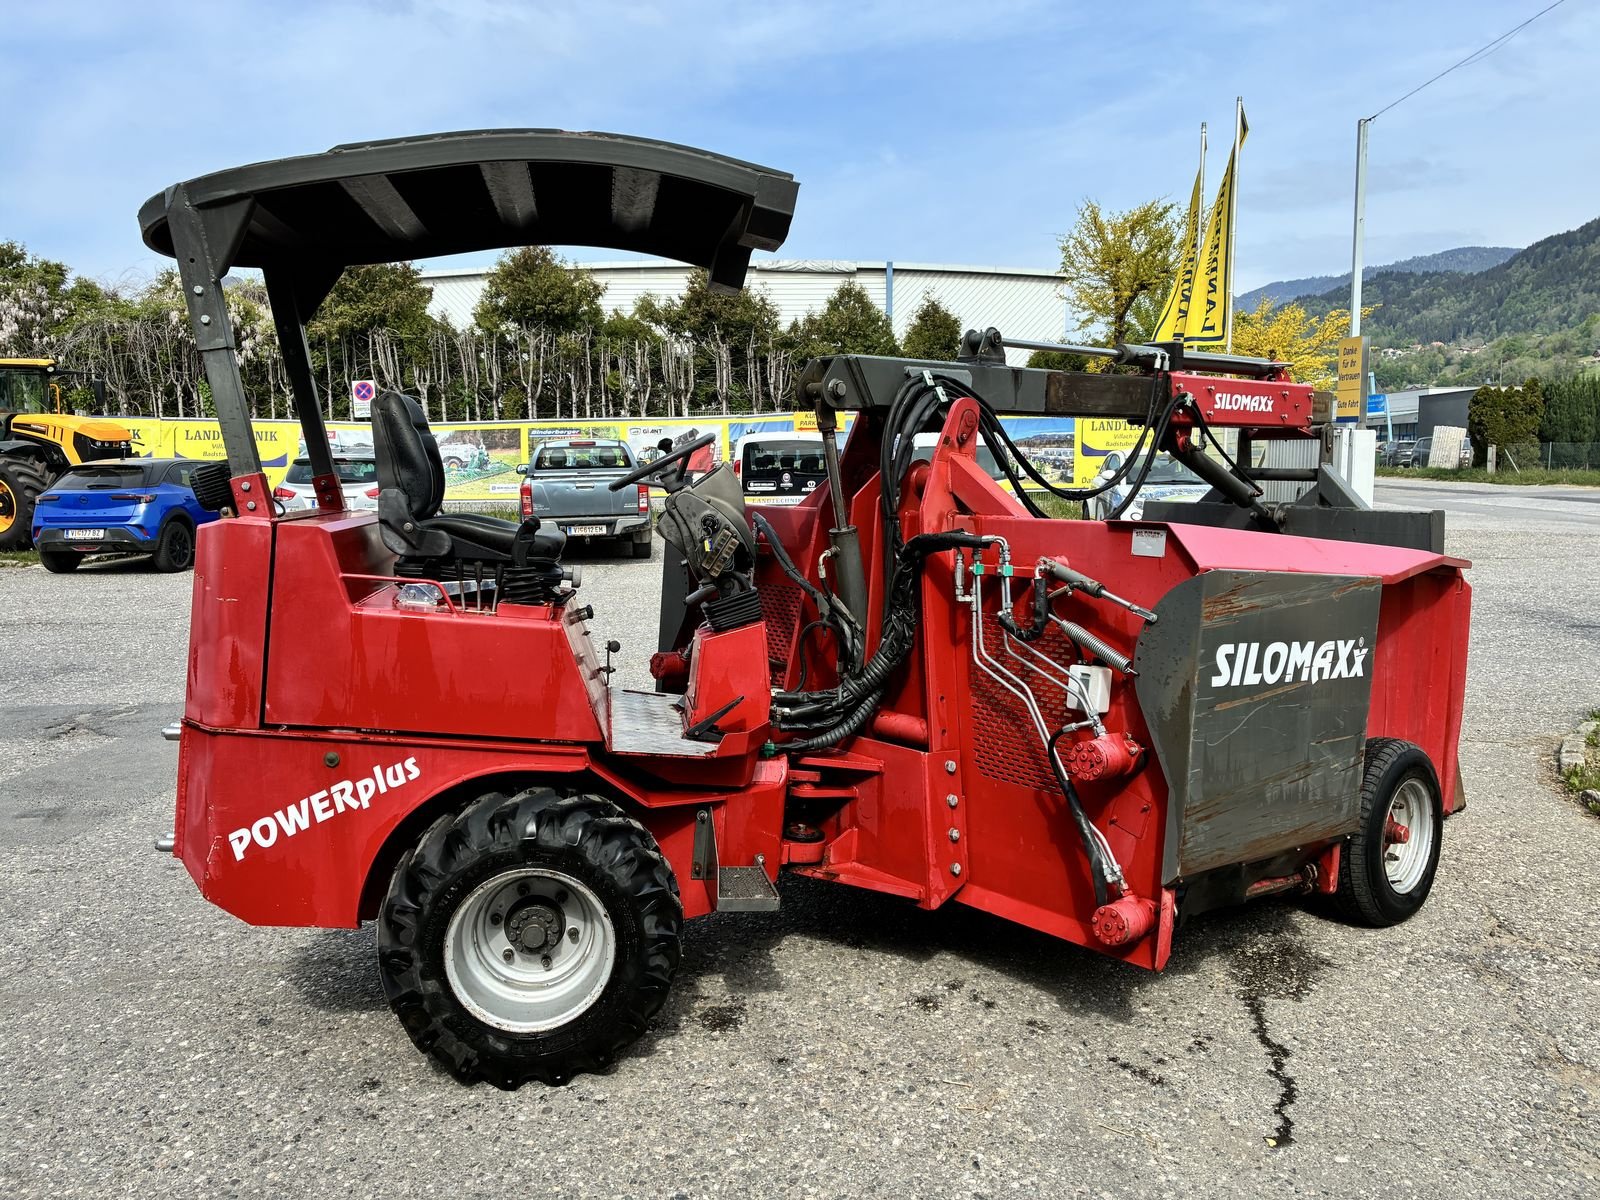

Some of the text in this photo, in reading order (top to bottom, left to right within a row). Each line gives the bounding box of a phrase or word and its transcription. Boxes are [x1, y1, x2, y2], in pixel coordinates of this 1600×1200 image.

[1343, 346, 1357, 356] Danke
[1338, 372, 1360, 381] Vertrauen
[1337, 400, 1347, 409] Gute
[1348, 399, 1359, 409] Fahrt
[228, 756, 421, 862] POWERplus
